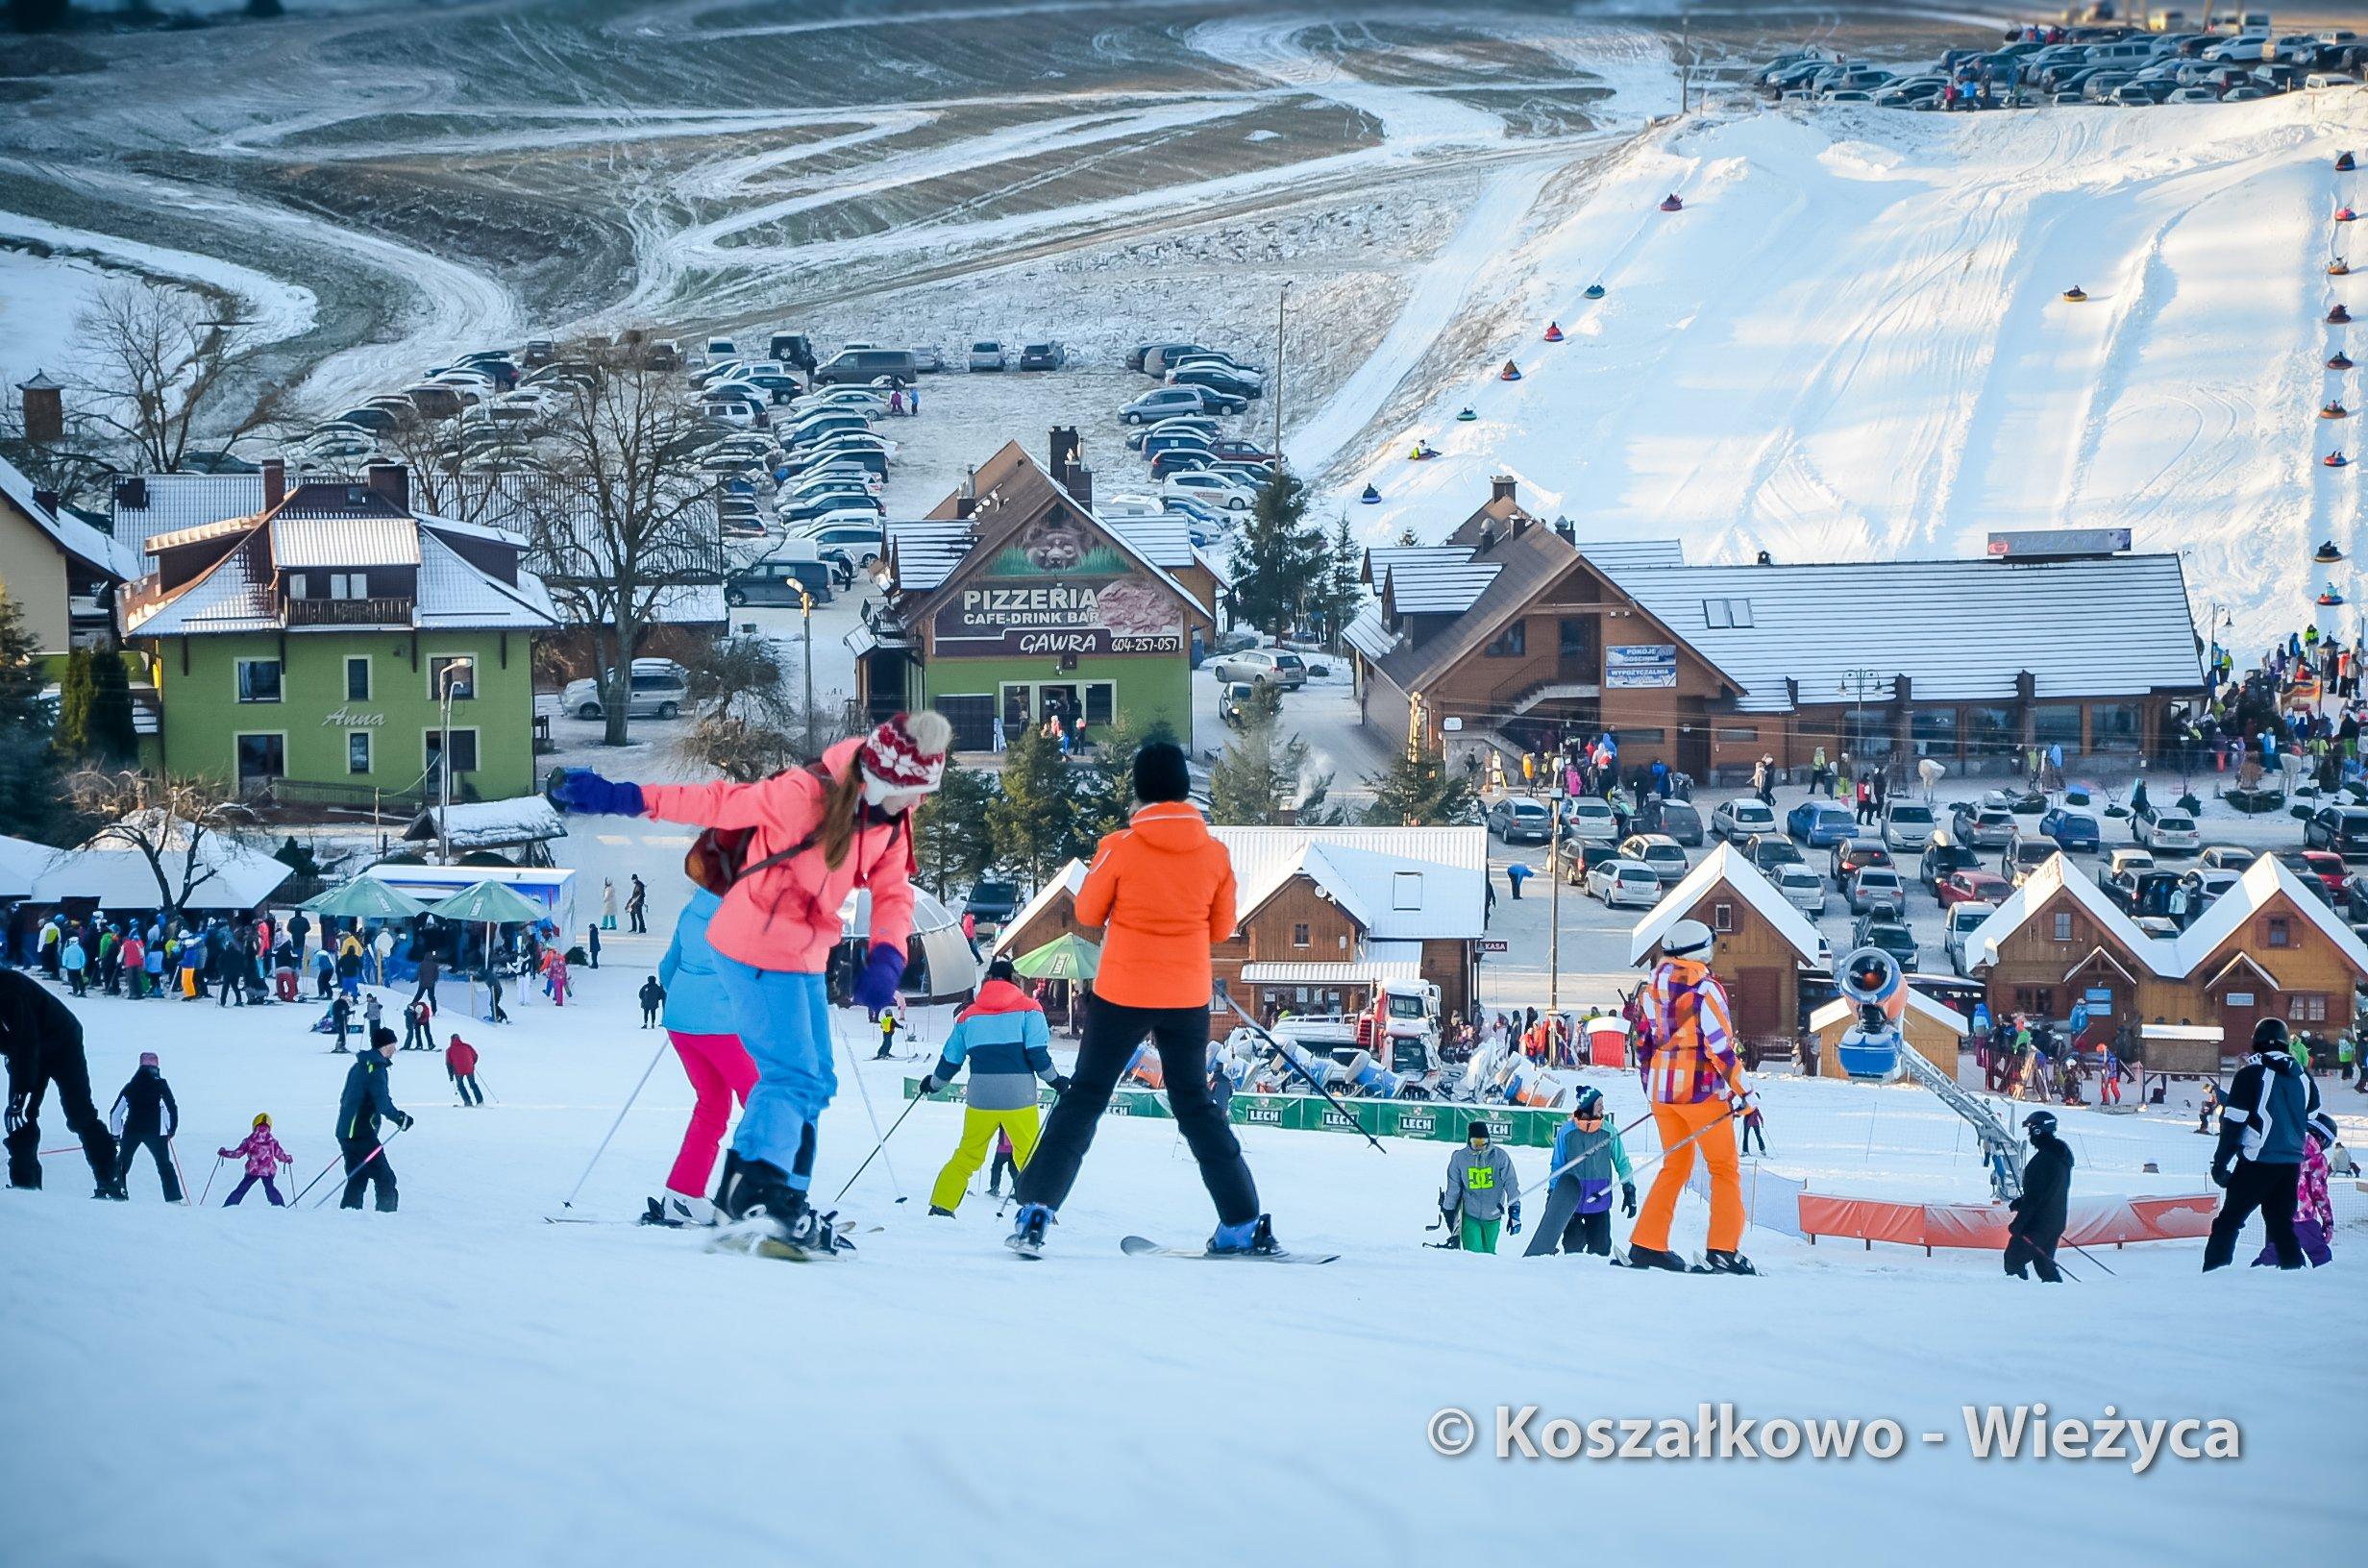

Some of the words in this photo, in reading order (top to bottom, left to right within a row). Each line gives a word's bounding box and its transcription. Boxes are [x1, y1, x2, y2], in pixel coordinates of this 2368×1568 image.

[964, 588, 1098, 611] PIZZERIA
[963, 611, 1063, 625] CAFE-DRINK
[1067, 610, 1100, 625] BAR
[1020, 633, 1097, 653] GAWRA
[1111, 637, 1177, 651] 604-257-057
[321, 705, 386, 726] Anna
[1106, 1106, 1128, 1116] ECH
[1249, 1109, 1279, 1122] LECH
[1402, 1116, 1432, 1130] LECH
[1485, 1122, 1509, 1135] ECH
